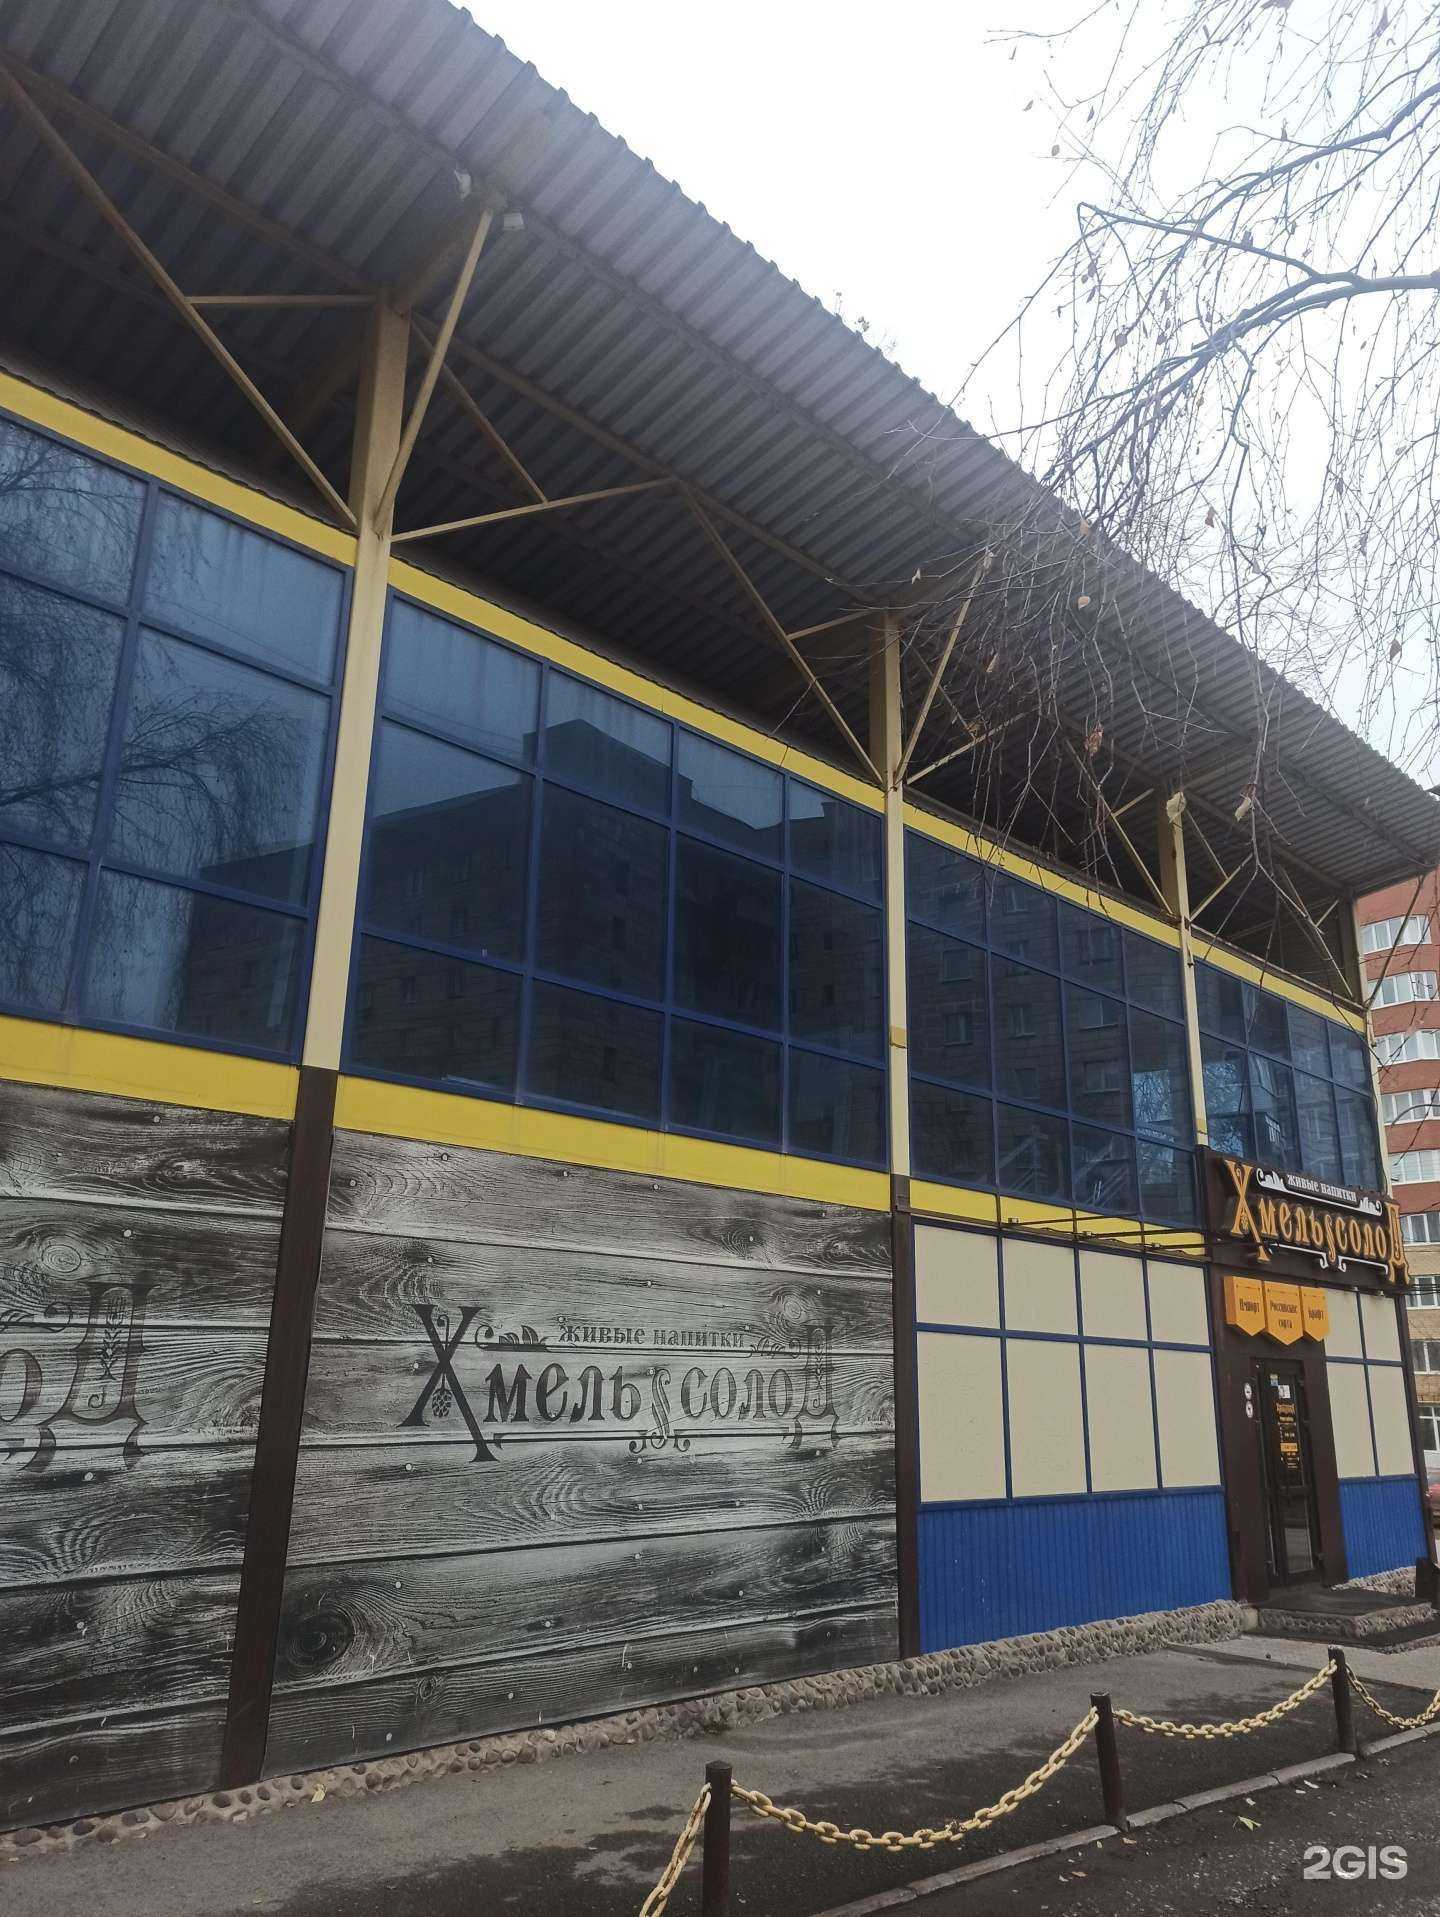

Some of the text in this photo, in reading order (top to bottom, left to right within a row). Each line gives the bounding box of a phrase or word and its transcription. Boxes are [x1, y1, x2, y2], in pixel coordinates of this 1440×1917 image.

[1286, 1174, 1358, 1203] живые напитки
[558, 1325, 748, 1348] живые напитки
